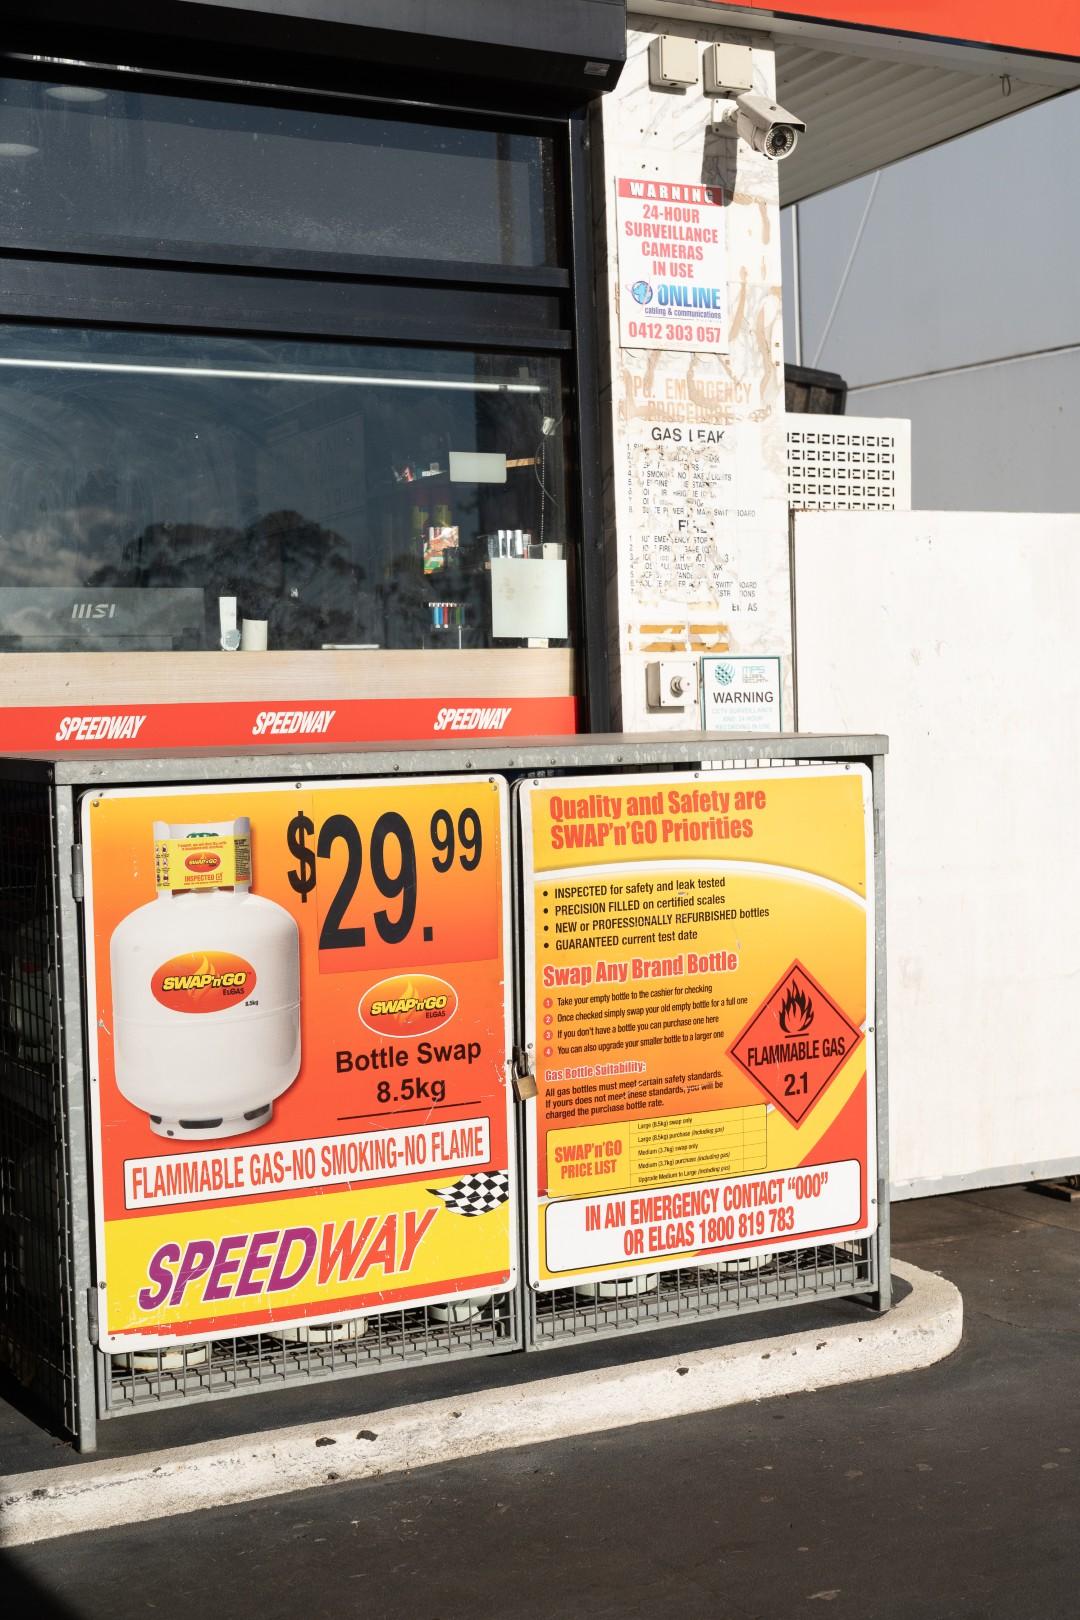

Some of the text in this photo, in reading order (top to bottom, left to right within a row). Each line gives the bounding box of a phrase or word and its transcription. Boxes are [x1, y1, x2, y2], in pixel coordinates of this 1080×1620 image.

[643, 204, 700, 224] 24-HOUR
[625, 221, 718, 243] SURVEILLANCE
[642, 242, 704, 260] CAMERAS
[653, 261, 694, 278] IN USE
[658, 284, 720, 310] ONLINE
[644, 307, 666, 317] cabling
[674, 310, 722, 319] communications
[629, 322, 720, 343] 0412 303 057
[652, 427, 682, 442] GAS
[713, 691, 774, 704] WARNING
[56, 715, 147, 741] SPEEDWAY
[252, 710, 336, 735] SPEEDWAY
[434, 708, 512, 730] SPEEDWAY
[550, 790, 766, 822] Quality and Safety are
[551, 816, 754, 850] SWAP'n'GO Priorities
[555, 877, 726, 898] INSPECTED for safety and leak tested
[555, 894, 726, 916] PRECISION FILLED on certified scales
[556, 908, 770, 933] NEW or PROFESSIONALLY REFURBISHED bottles
[556, 930, 698, 950] GUARANTEED current test date
[544, 952, 737, 986] Swap Any Brand Bottle
[162, 972, 246, 991] SWAP'n'GO
[370, 995, 448, 1016] SWAP'n'GO
[558, 984, 712, 1006] Take your empty bottle to the cashier for checking
[558, 1014, 574, 1022] Once
[576, 1010, 602, 1020] checked
[604, 1009, 625, 1018] simply
[626, 1008, 644, 1016] swap
[646, 1006, 659, 1016] your
[661, 1004, 670, 1012] old
[672, 1002, 691, 1012] empty
[692, 1000, 710, 1010] bottle
[558, 1030, 562, 1038] If
[564, 1031, 576, 1040] you
[577, 1026, 594, 1036] don't
[595, 1026, 610, 1035] have
[618, 1024, 636, 1032] bottle
[637, 1024, 648, 1032] you
[663, 1018, 692, 1030] purchase
[558, 1046, 570, 1054] You
[584, 1044, 596, 1052] also
[598, 1040, 624, 1052] upgrade
[625, 1040, 639, 1049] your
[640, 1036, 662, 1046] smaller
[664, 1034, 681, 1044] bottle
[694, 1032, 712, 1041] larger
[748, 1037, 845, 1066] FLAMMABLE GAS
[336, 1042, 481, 1073] Bottle Swap
[546, 1062, 646, 1080] Gas Bottle Suitability:
[377, 1078, 446, 1103] 8.5kg
[546, 1088, 554, 1096] All
[557, 1088, 570, 1098] gas
[572, 1084, 596, 1095] bottles
[599, 1082, 617, 1090] must
[619, 1080, 636, 1088] meet
[664, 1074, 686, 1084] safety
[688, 1070, 723, 1080] standards.
[784, 1072, 808, 1096] 2.1
[546, 1100, 550, 1108] If
[553, 1100, 573, 1109] yours
[575, 1096, 592, 1105] does
[594, 1094, 606, 1102] not
[608, 1092, 626, 1100] meet
[648, 1086, 686, 1096] standards,
[546, 1099, 664, 1119] charged the purchase bottle rate.
[555, 1140, 622, 1163] SWAP'n'GO
[132, 1156, 245, 1200] FLAMMABLE
[432, 1126, 484, 1162] FLAME
[561, 1160, 616, 1179] PRICE LIST
[586, 1204, 600, 1231] IN
[605, 1201, 626, 1228] AN
[630, 1188, 720, 1225] EMERGENCY
[724, 1178, 784, 1214] CONTACT
[624, 1206, 794, 1255] OR ELGAS 1800 819 783
[138, 1207, 438, 1311] SPEEDWAY
